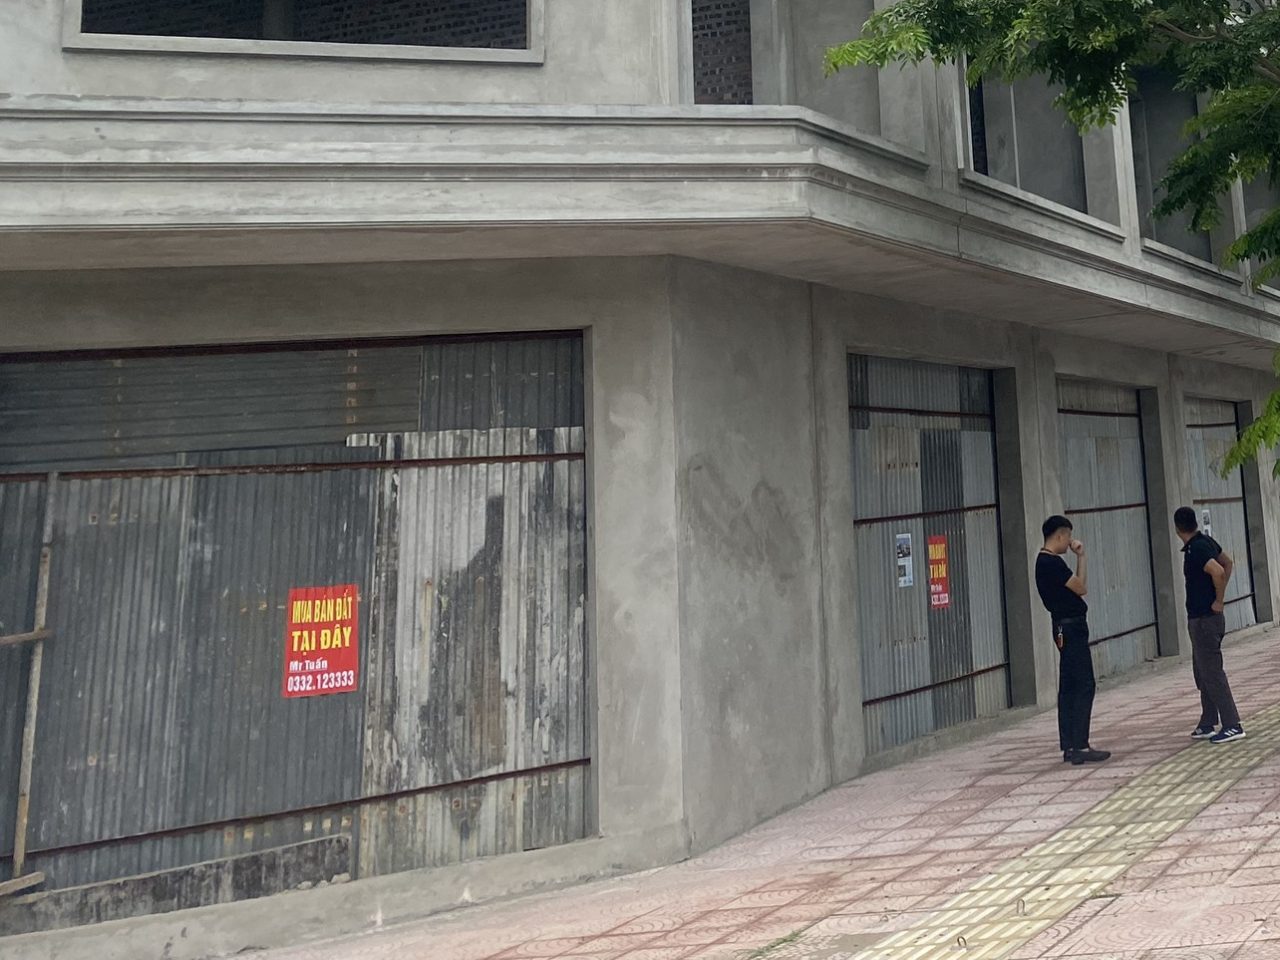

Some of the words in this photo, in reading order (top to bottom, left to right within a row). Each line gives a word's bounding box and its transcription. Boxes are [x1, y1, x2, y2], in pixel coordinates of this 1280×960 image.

[292, 600, 312, 623] MUA
[314, 594, 334, 622] BÁN
[336, 589, 353, 620] ĐẤT
[292, 630, 316, 656] TẠI
[320, 624, 352, 650] ĐÂY
[289, 660, 303, 672] Mr
[305, 657, 328, 670] Tuấn
[287, 670, 354, 692] 0332.123333
